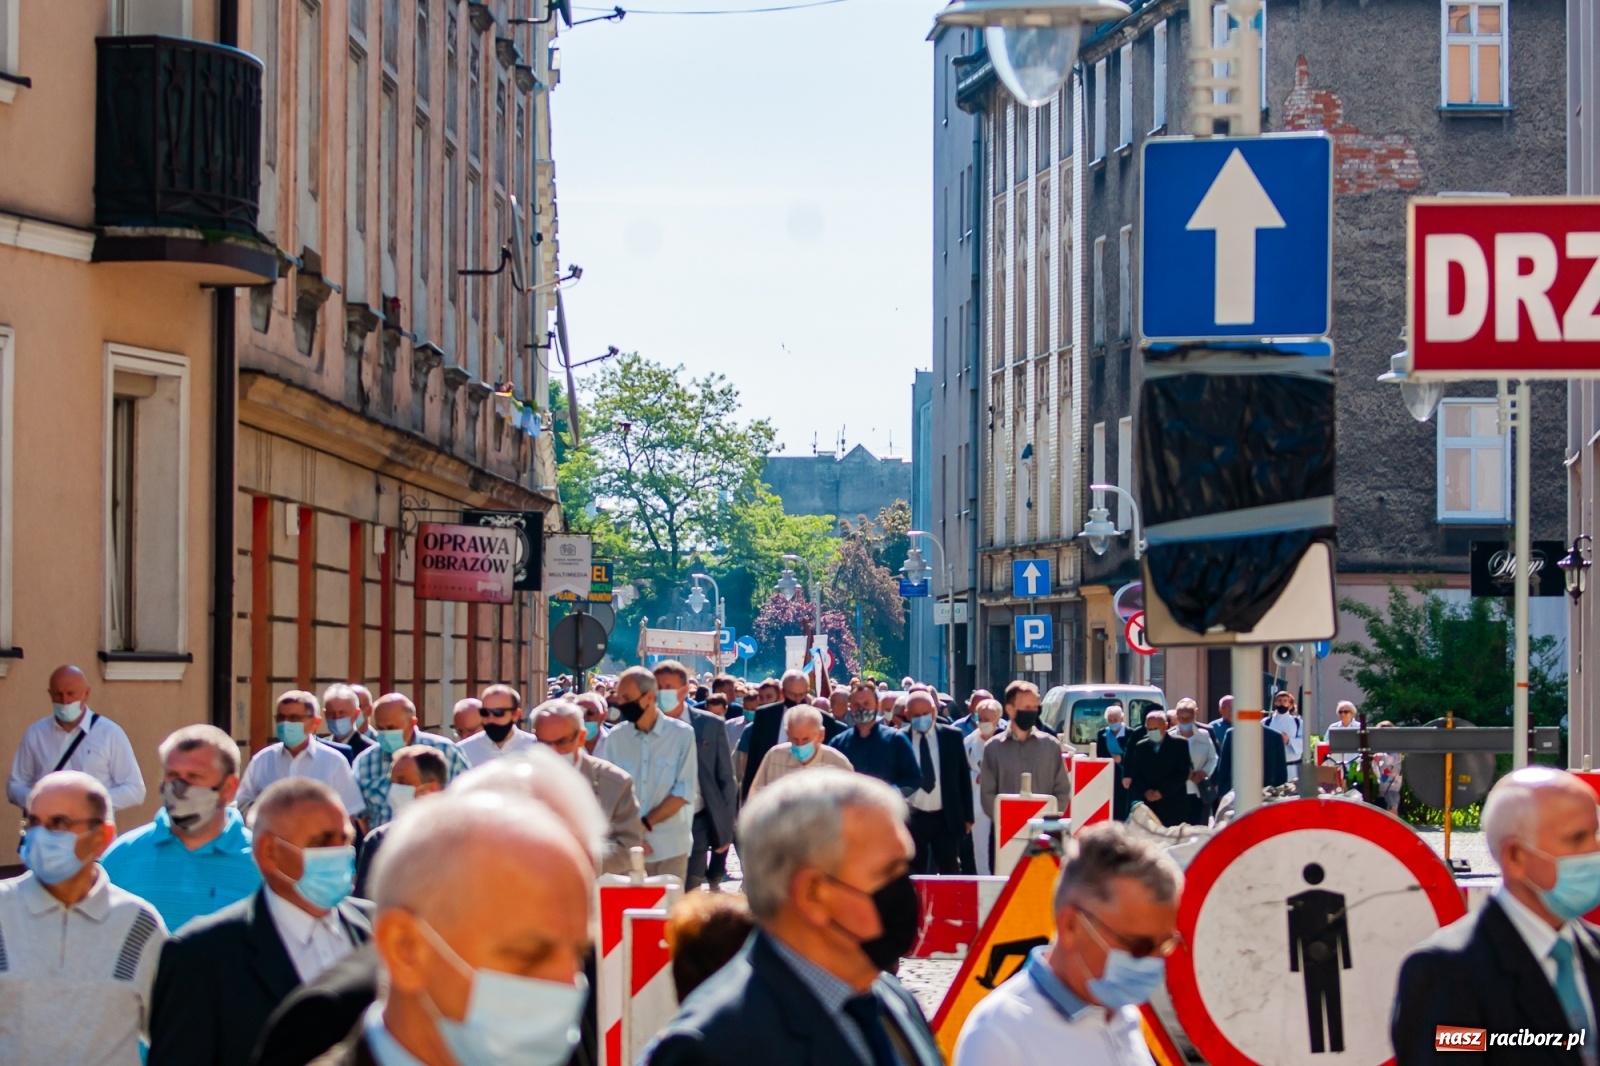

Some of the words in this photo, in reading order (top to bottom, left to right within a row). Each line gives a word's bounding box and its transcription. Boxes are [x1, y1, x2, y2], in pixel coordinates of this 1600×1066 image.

[423, 532, 510, 555] OPRAWA
[421, 553, 509, 574] OBRAZÓW
[1024, 619, 1044, 648] P
